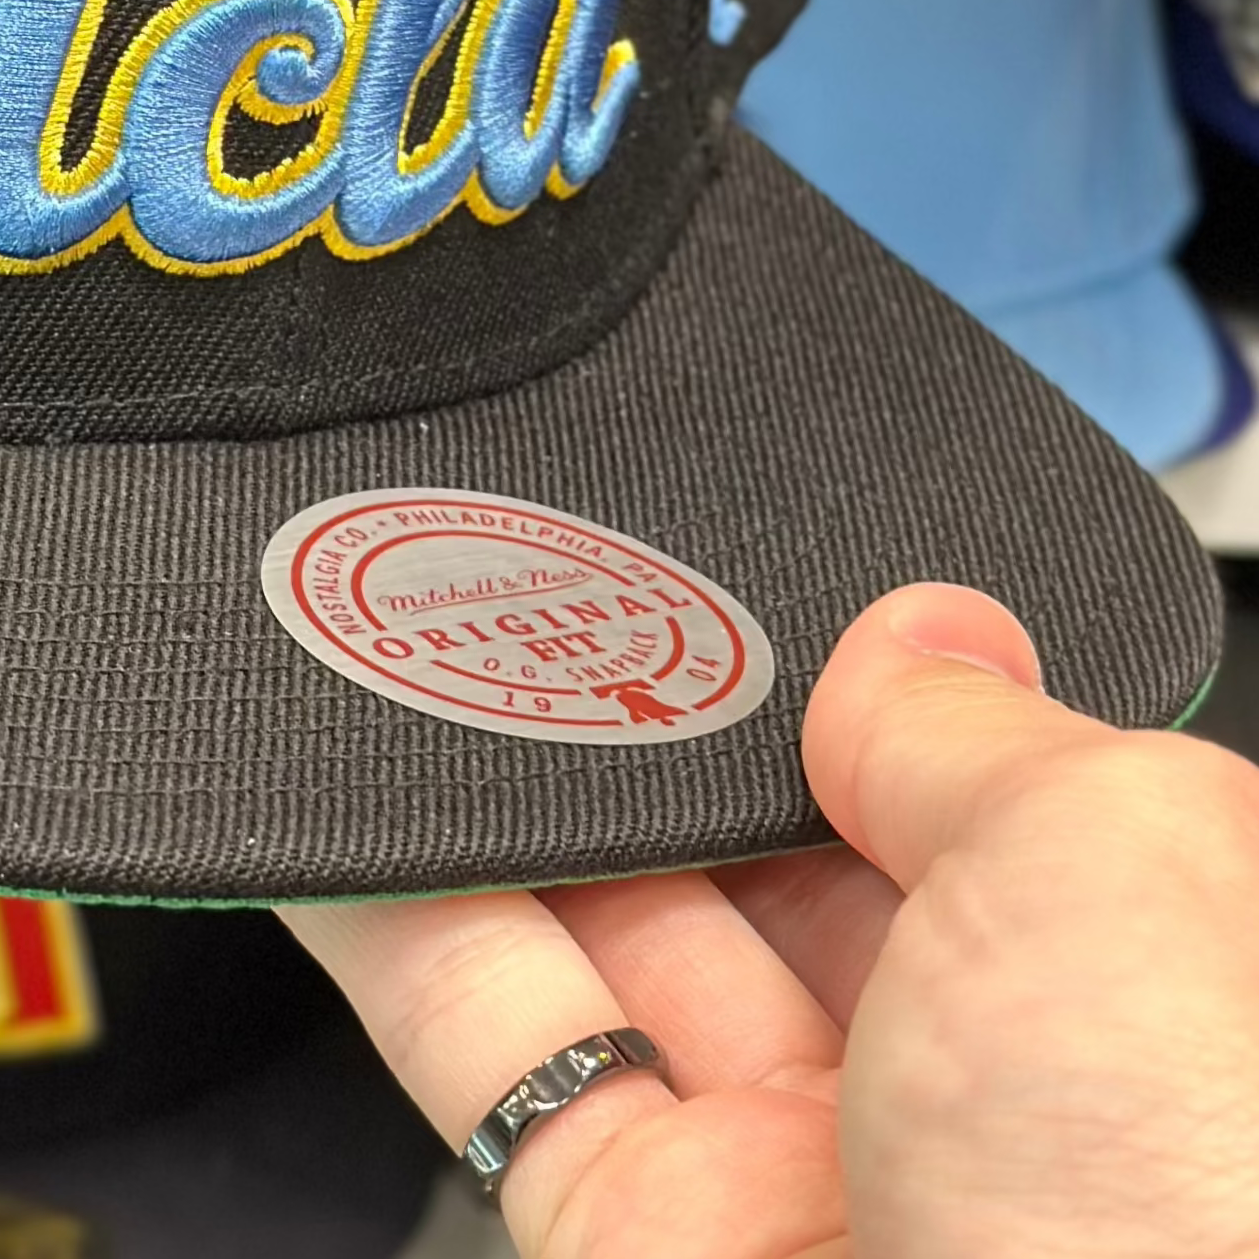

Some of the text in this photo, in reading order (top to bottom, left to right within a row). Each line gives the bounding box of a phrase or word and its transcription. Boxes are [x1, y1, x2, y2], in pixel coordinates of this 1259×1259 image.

[312, 548, 368, 636] NOSTALGIA
[622, 561, 659, 584] PA
[377, 568, 590, 613] Mitchell & Ness
[371, 587, 692, 660] ORIGINAL
[519, 630, 607, 663] FIT
[501, 653, 723, 714] 19 04
[565, 629, 660, 682] SNAPBACK
